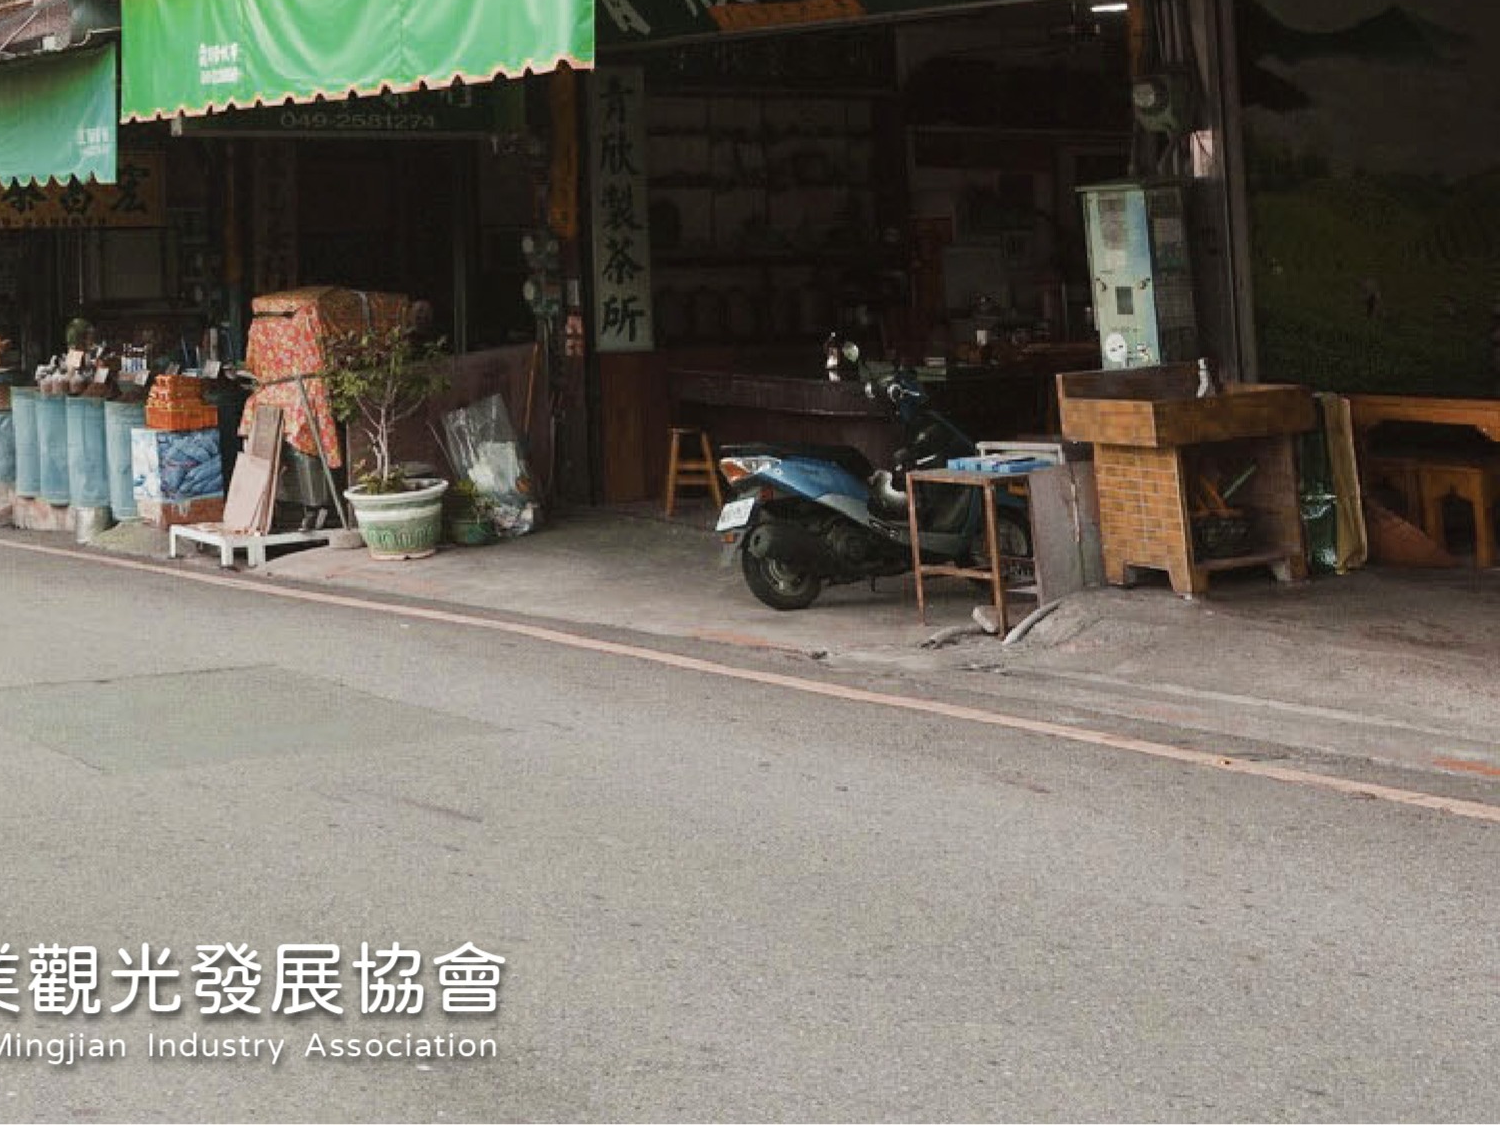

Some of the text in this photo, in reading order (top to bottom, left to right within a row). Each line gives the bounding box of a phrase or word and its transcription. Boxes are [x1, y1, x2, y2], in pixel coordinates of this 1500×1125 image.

[600, 77, 645, 342] 青欣製茶所
